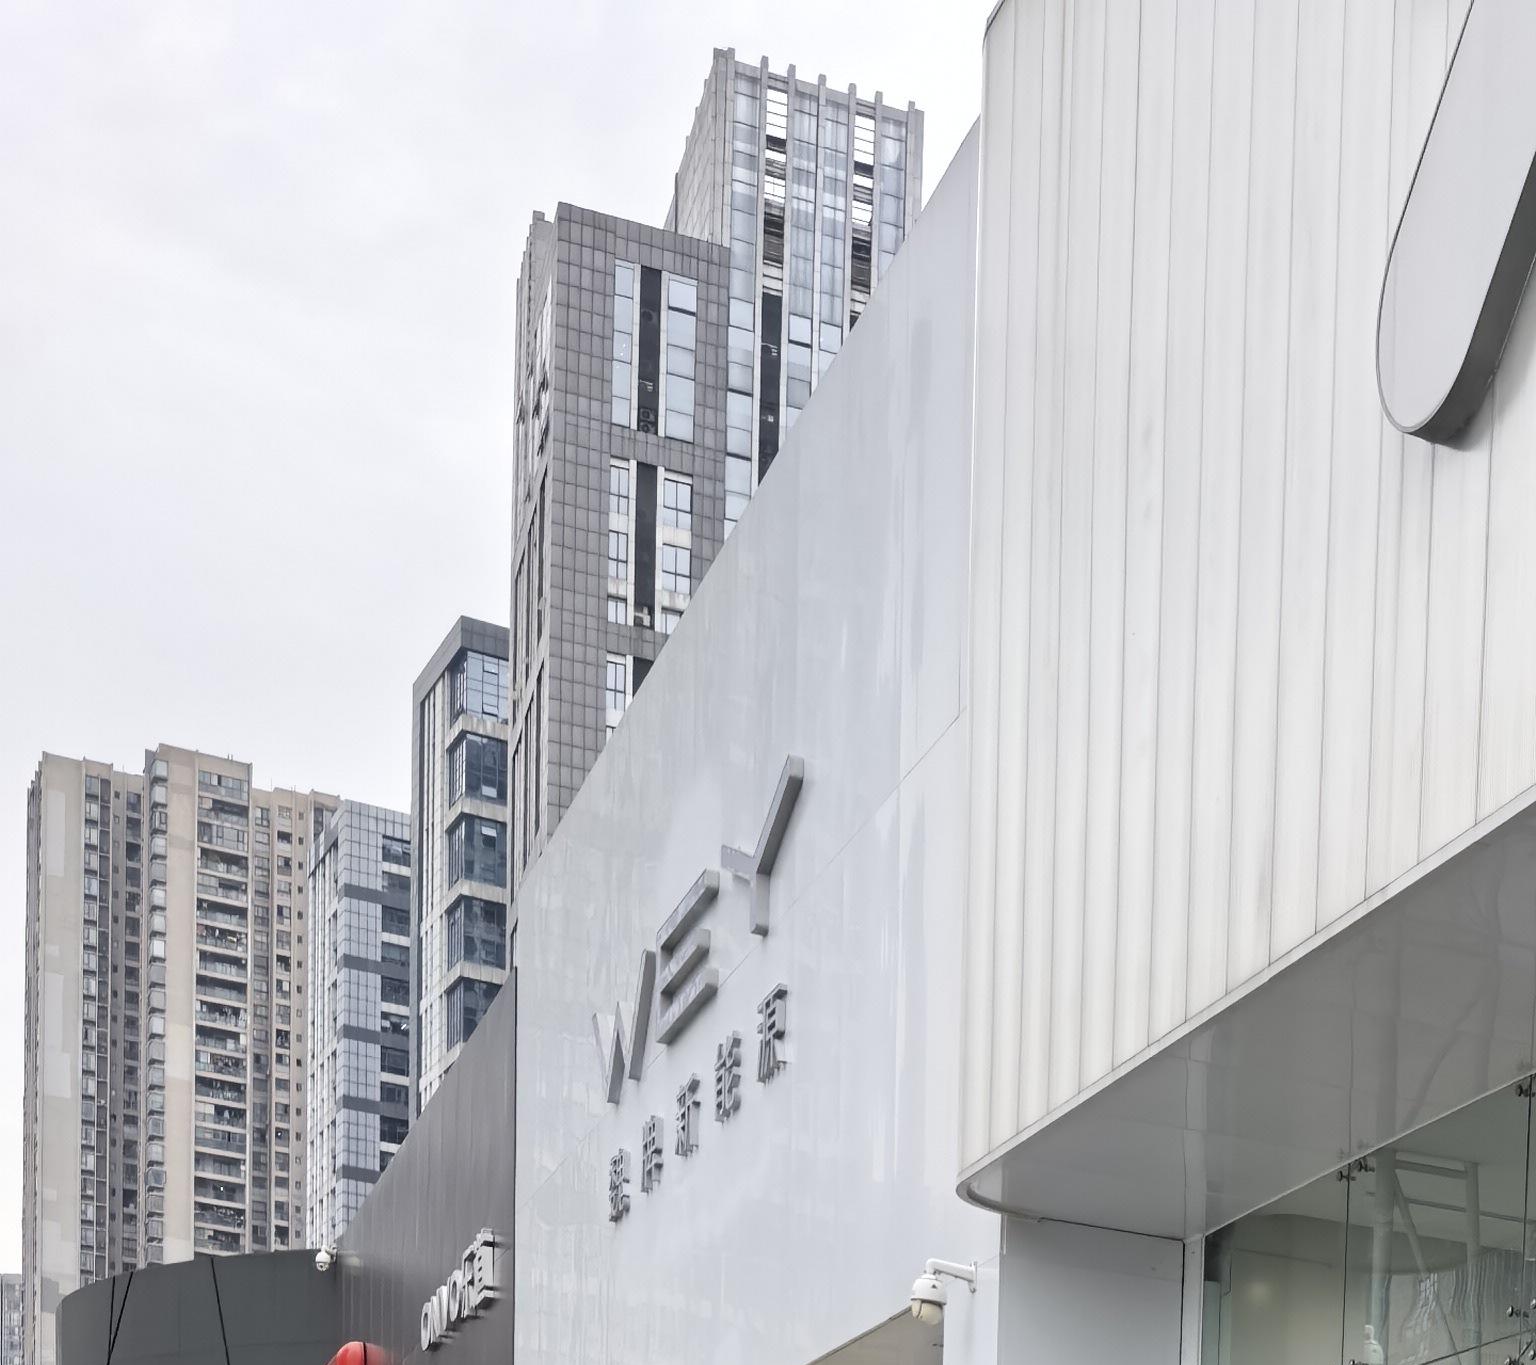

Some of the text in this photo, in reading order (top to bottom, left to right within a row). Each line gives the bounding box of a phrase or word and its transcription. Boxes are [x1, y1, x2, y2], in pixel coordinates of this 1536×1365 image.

[592, 754, 805, 1104] WEY
[608, 982, 789, 1224] 魏牌新能源
